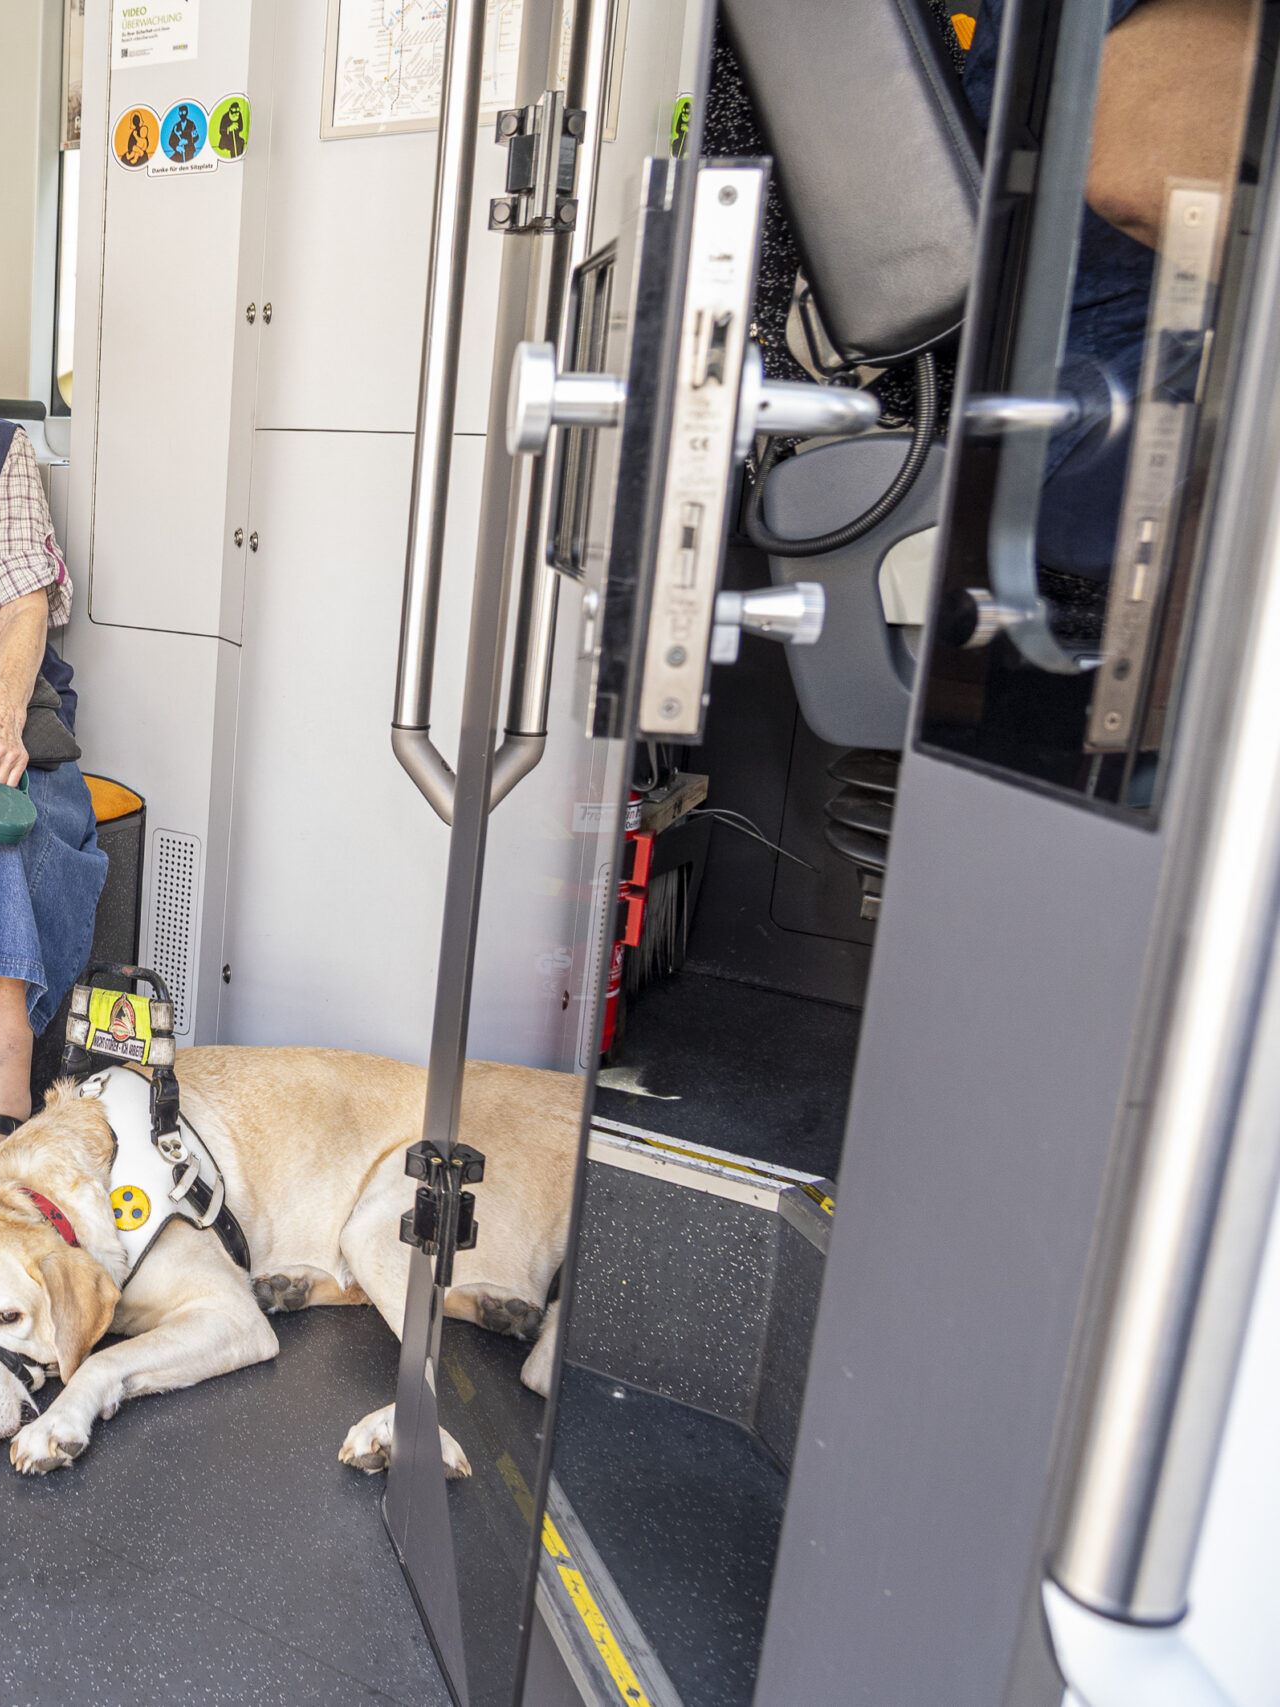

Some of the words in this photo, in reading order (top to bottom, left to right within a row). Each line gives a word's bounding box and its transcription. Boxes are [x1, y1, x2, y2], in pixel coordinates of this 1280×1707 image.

[122, 6, 147, 18] VIDEO
[121, 12, 183, 31] ÜBERWACHUNG
[190, 162, 213, 171] Sitzplatz
